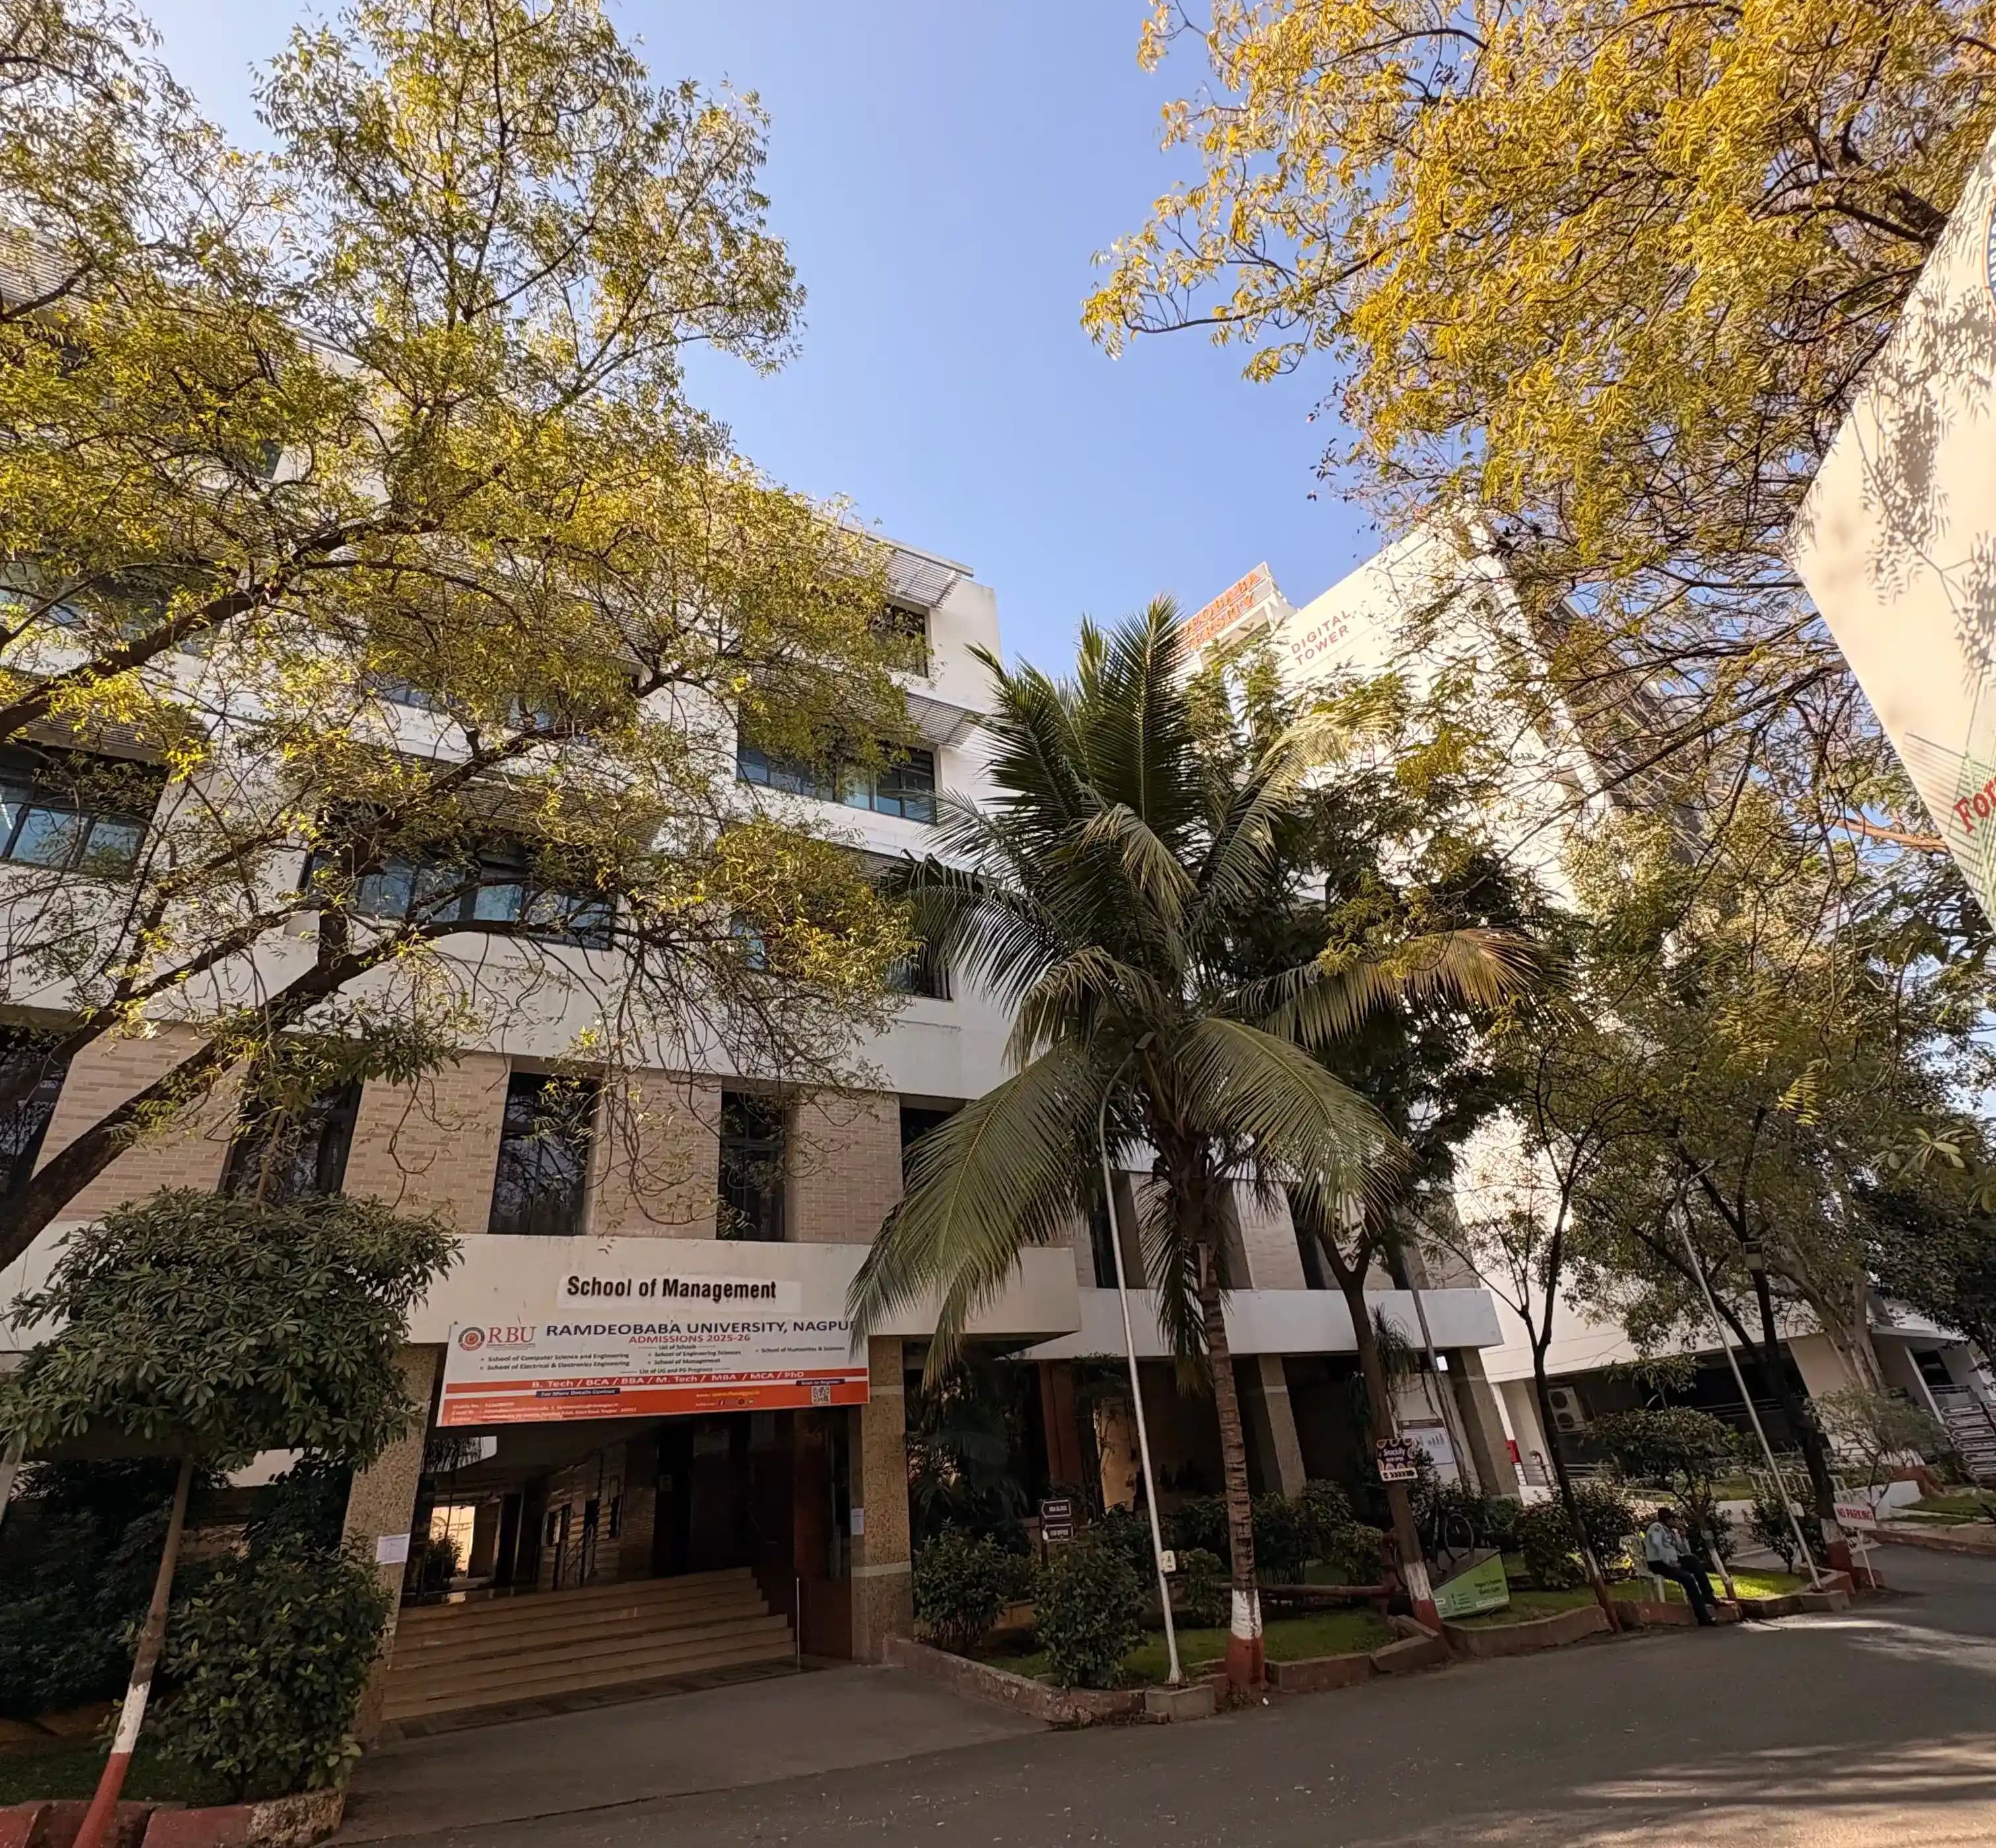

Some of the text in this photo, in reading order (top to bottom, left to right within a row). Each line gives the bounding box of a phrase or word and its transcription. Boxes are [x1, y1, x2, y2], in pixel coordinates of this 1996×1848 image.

[1291, 610, 1350, 654] DIGITAL
[1294, 624, 1349, 665] TOWER
[567, 1275, 776, 1303] School of Management
[487, 1326, 537, 1343] RBU
[547, 1322, 681, 1336] RAMDEOBABA
[687, 1321, 787, 1334] UNIVERSITY,
[628, 1333, 750, 1344] ADMISSIONS 2025-26
[682, 1350, 716, 1358] Engineering
[585, 1377, 609, 1386] BCA
[1837, 1507, 1873, 1521] NO PARKING
